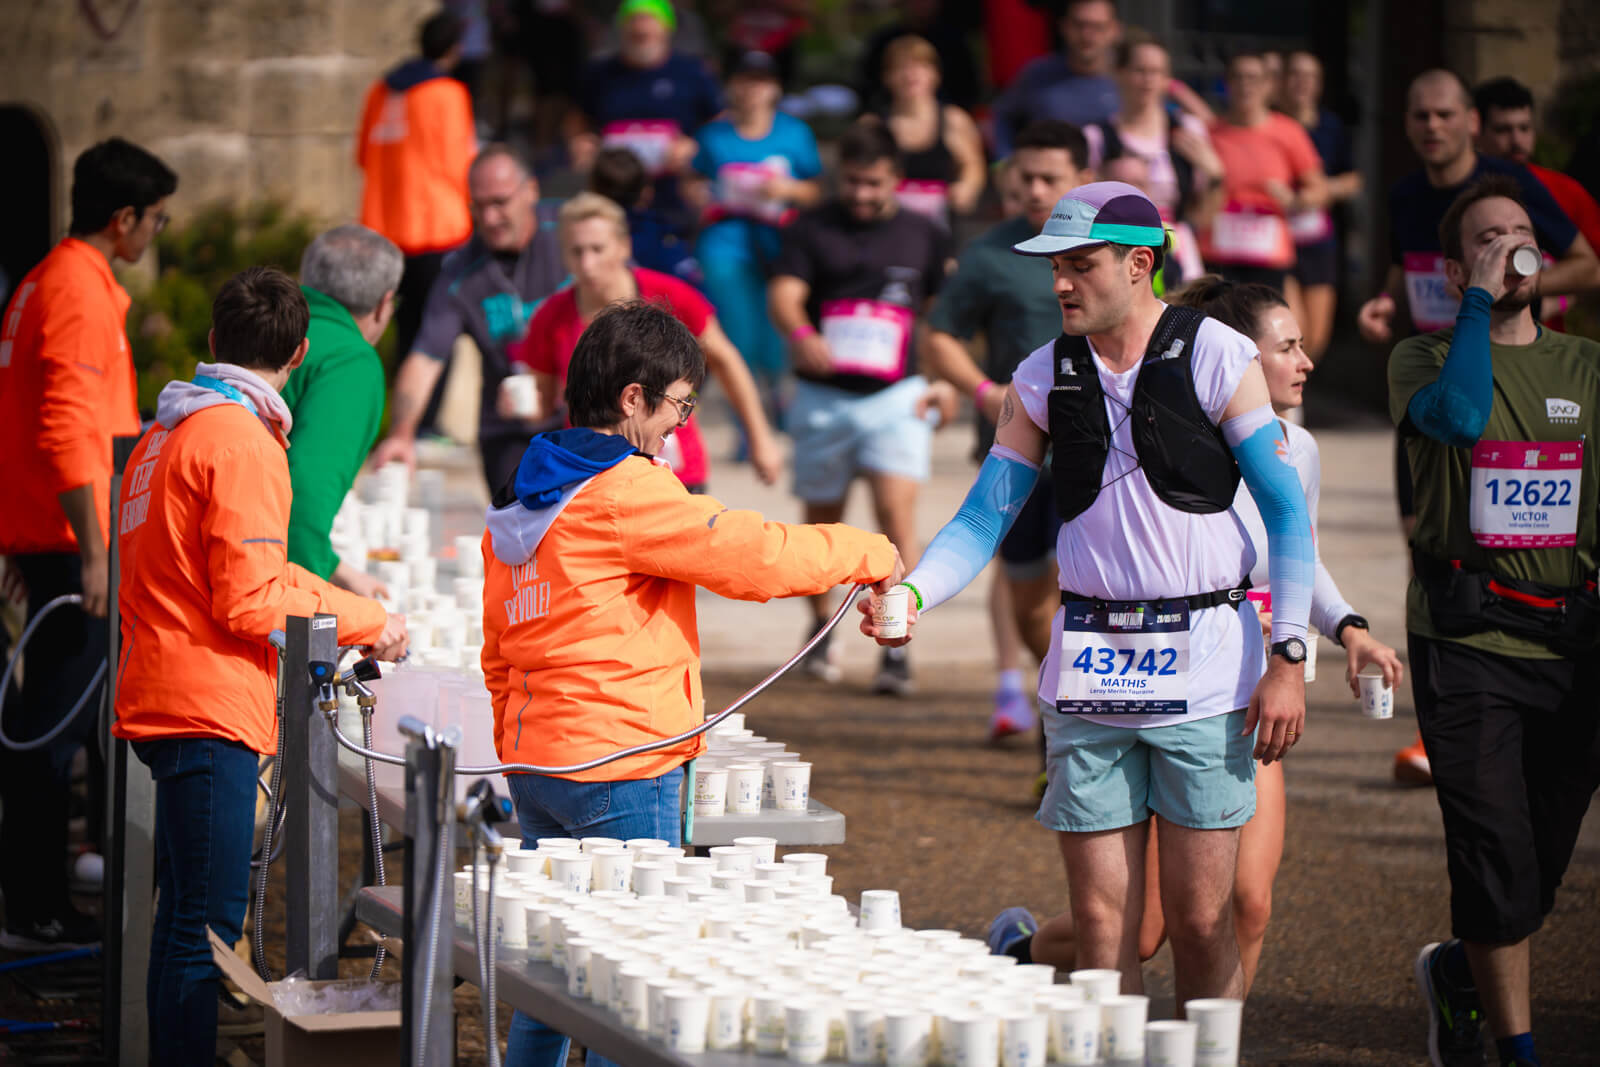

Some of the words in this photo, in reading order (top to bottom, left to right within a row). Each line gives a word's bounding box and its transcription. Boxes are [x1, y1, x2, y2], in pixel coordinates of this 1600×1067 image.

[1550, 405, 1578, 415] SNCF
[1485, 478, 1572, 507] 12622
[1511, 511, 1548, 521] VICTOR
[1072, 646, 1178, 677] 43742
[1100, 678, 1148, 689] MATHIS
